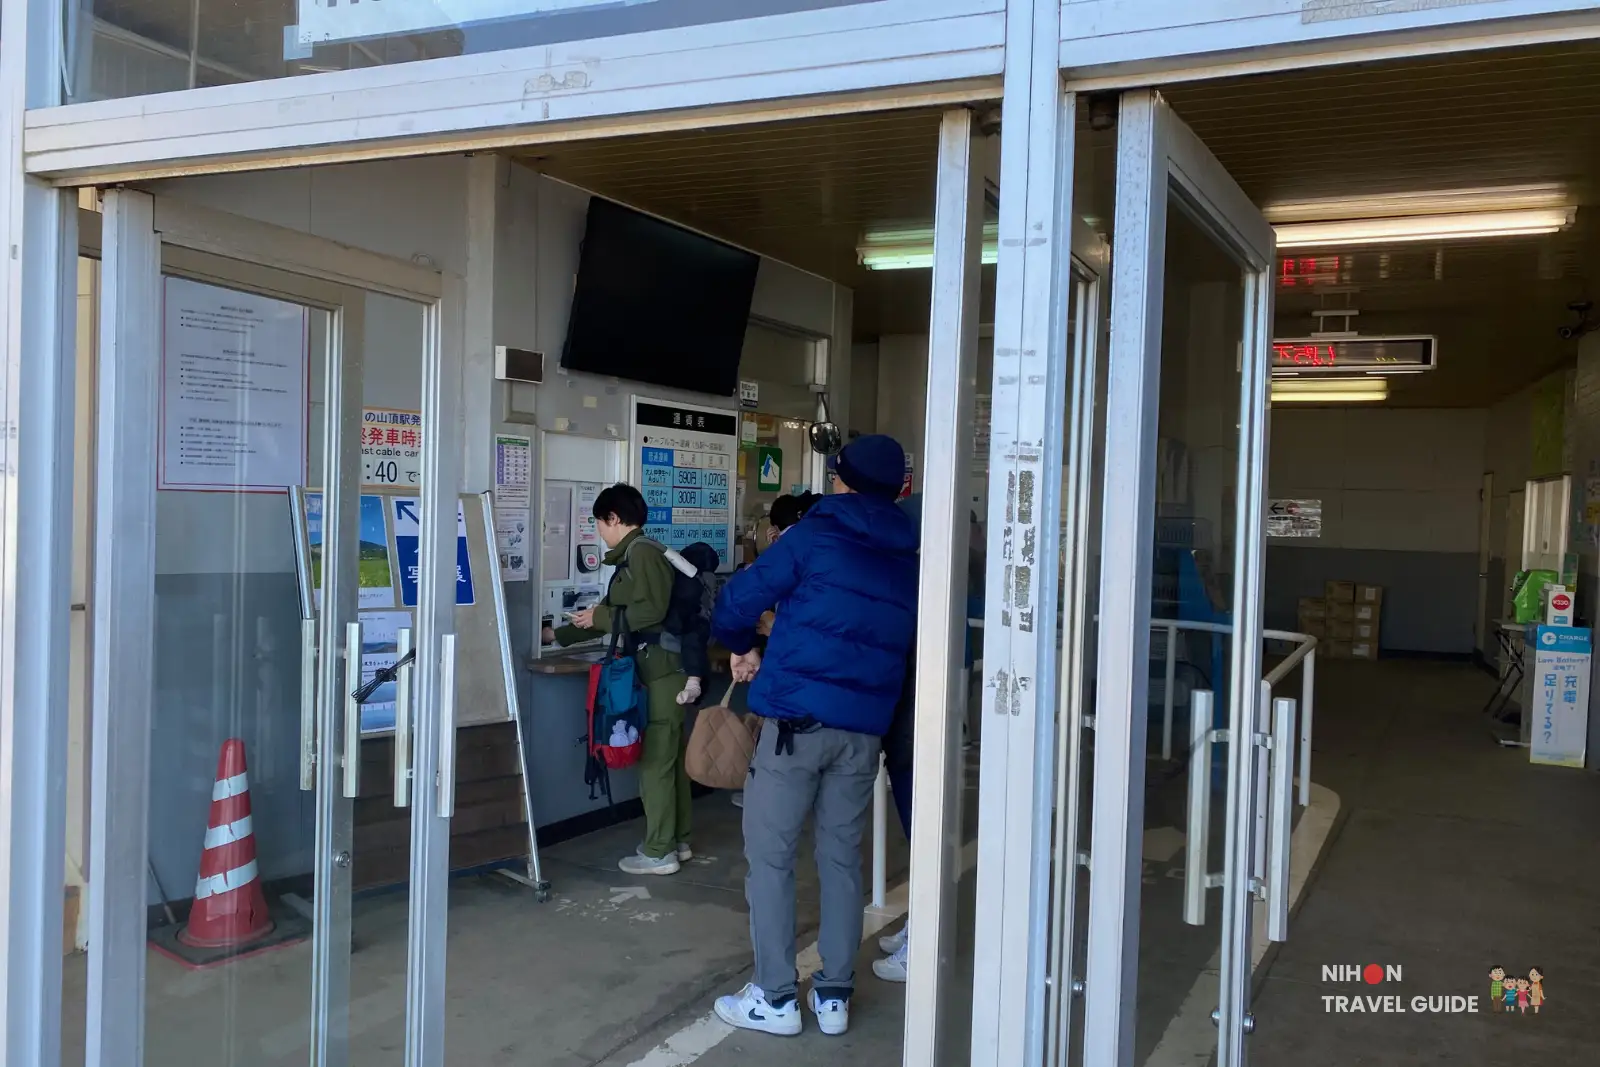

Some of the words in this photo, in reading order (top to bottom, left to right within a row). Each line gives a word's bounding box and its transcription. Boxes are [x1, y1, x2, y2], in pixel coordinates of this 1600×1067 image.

[361, 427, 421, 447] 発車時
[376, 448, 401, 457] cable
[405, 470, 421, 483] で
[678, 490, 697, 505] 300円
[1558, 634, 1589, 642] CHARGE
